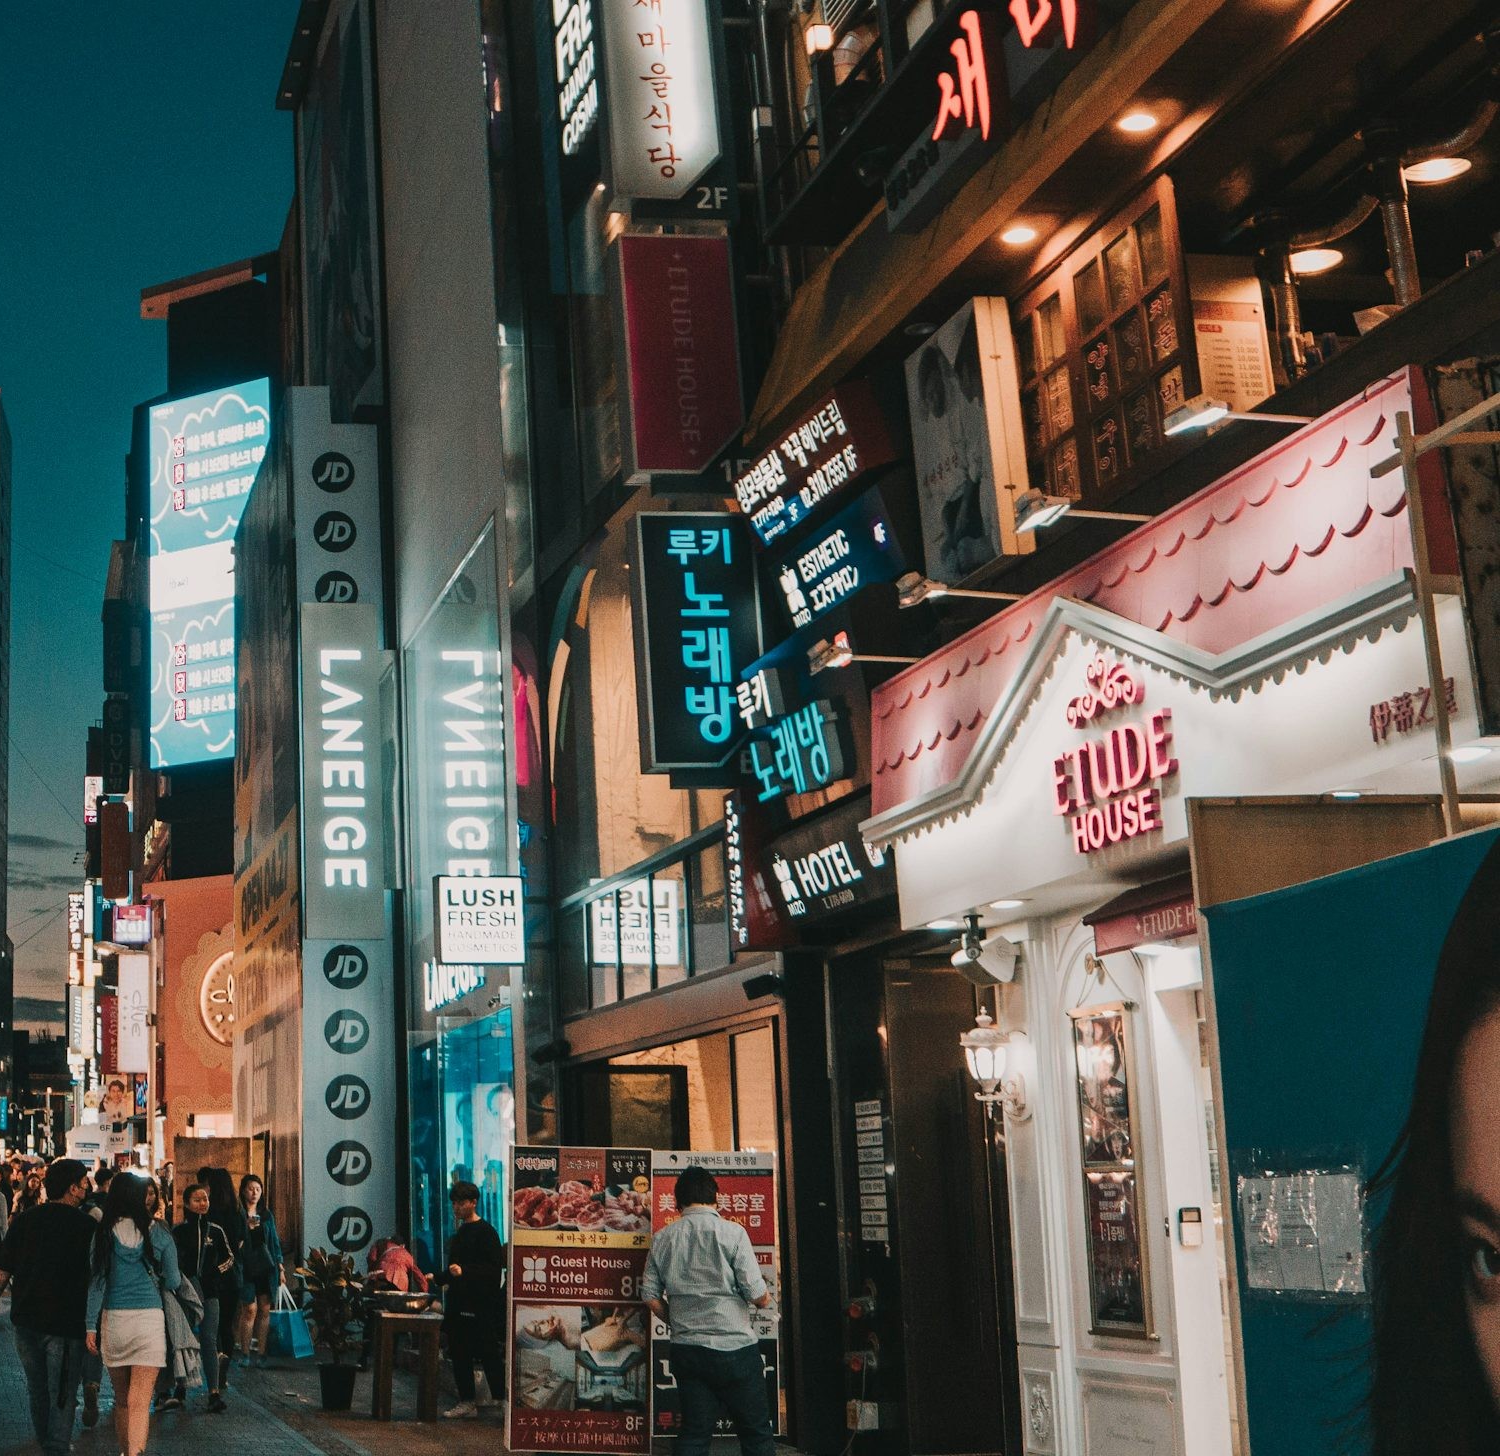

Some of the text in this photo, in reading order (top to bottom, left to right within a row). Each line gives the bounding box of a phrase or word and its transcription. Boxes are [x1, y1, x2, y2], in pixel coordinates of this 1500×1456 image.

[697, 187, 728, 209] 2F
[668, 266, 700, 443] ETUDE HOUSE
[318, 461, 350, 483] JD
[319, 520, 352, 543] JD
[667, 528, 732, 565] 루키
[797, 529, 850, 583] ESTHETIC
[320, 580, 354, 602] JD
[680, 572, 736, 743] 노래방
[751, 702, 831, 802] 노래방
[1053, 707, 1179, 817] ETUDE
[319, 649, 367, 888] LANEIGE
[1072, 788, 1163, 854] HOUSE
[794, 831, 863, 897] HOTEL
[447, 889, 515, 907] LUSH
[448, 911, 516, 927] FRESH
[1143, 911, 1184, 937] ETUDE
[329, 955, 362, 978] JD
[330, 1020, 363, 1043] JD
[331, 1085, 365, 1108] JD
[332, 1151, 366, 1175] JD
[333, 1217, 367, 1241] JD
[550, 1255, 631, 1269] Guest House
[522, 1283, 547, 1292] MIZO
[550, 1271, 588, 1284] Hotel
[759, 1325, 772, 1335] 3F
[625, 1416, 644, 1431] 8F
